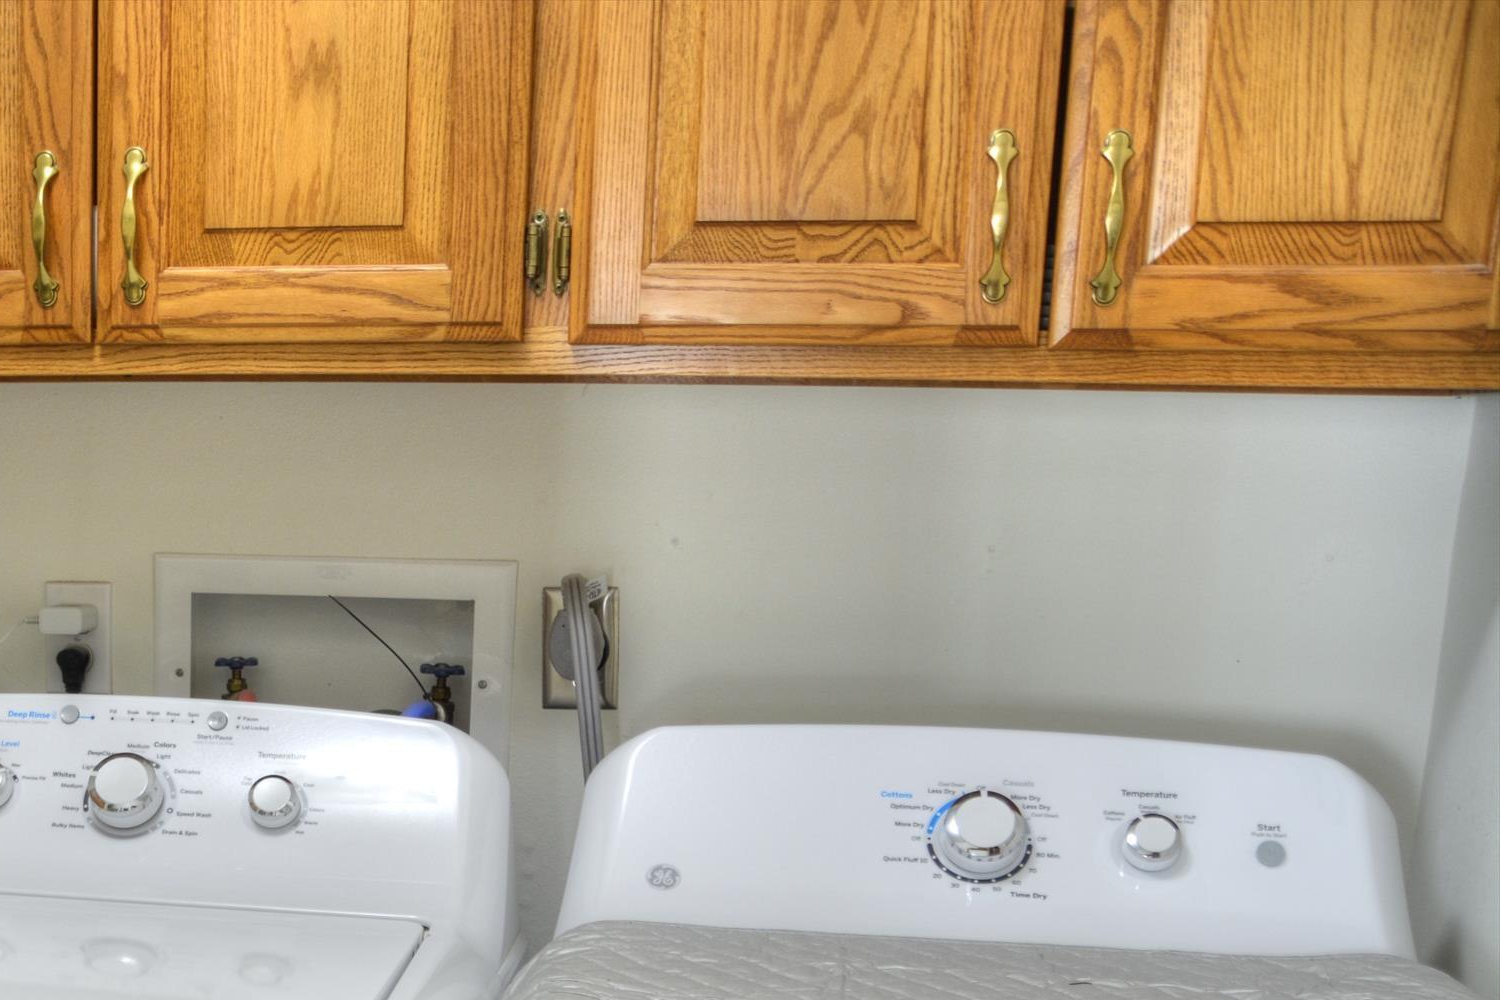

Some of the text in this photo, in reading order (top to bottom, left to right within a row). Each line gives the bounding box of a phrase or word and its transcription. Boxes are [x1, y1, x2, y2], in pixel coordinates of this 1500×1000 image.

[8, 710, 28, 720] Deep
[258, 751, 306, 760] Temperature
[1121, 789, 1178, 799] Temperature
[890, 803, 920, 812] Optimum
[1257, 824, 1281, 832] Start
